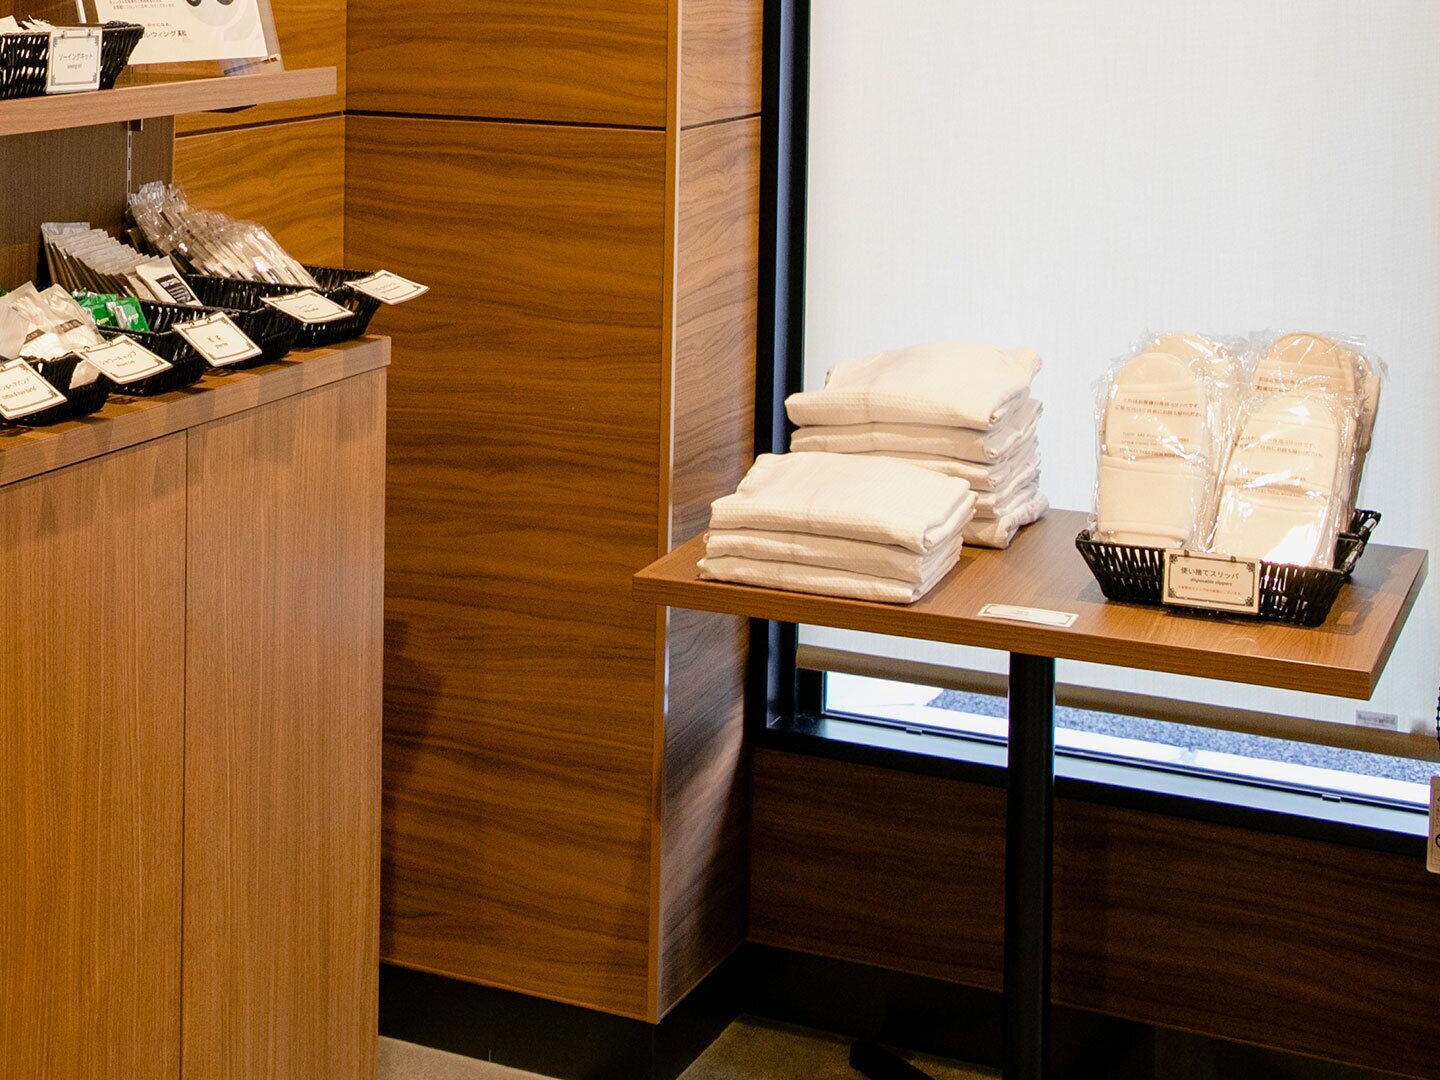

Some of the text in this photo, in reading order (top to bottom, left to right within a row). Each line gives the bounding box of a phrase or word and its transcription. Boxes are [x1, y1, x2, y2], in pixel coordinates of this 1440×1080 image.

[59, 52, 94, 62] ソーイングキット
[1180, 566, 1239, 580] 使い捨てスリッパ
